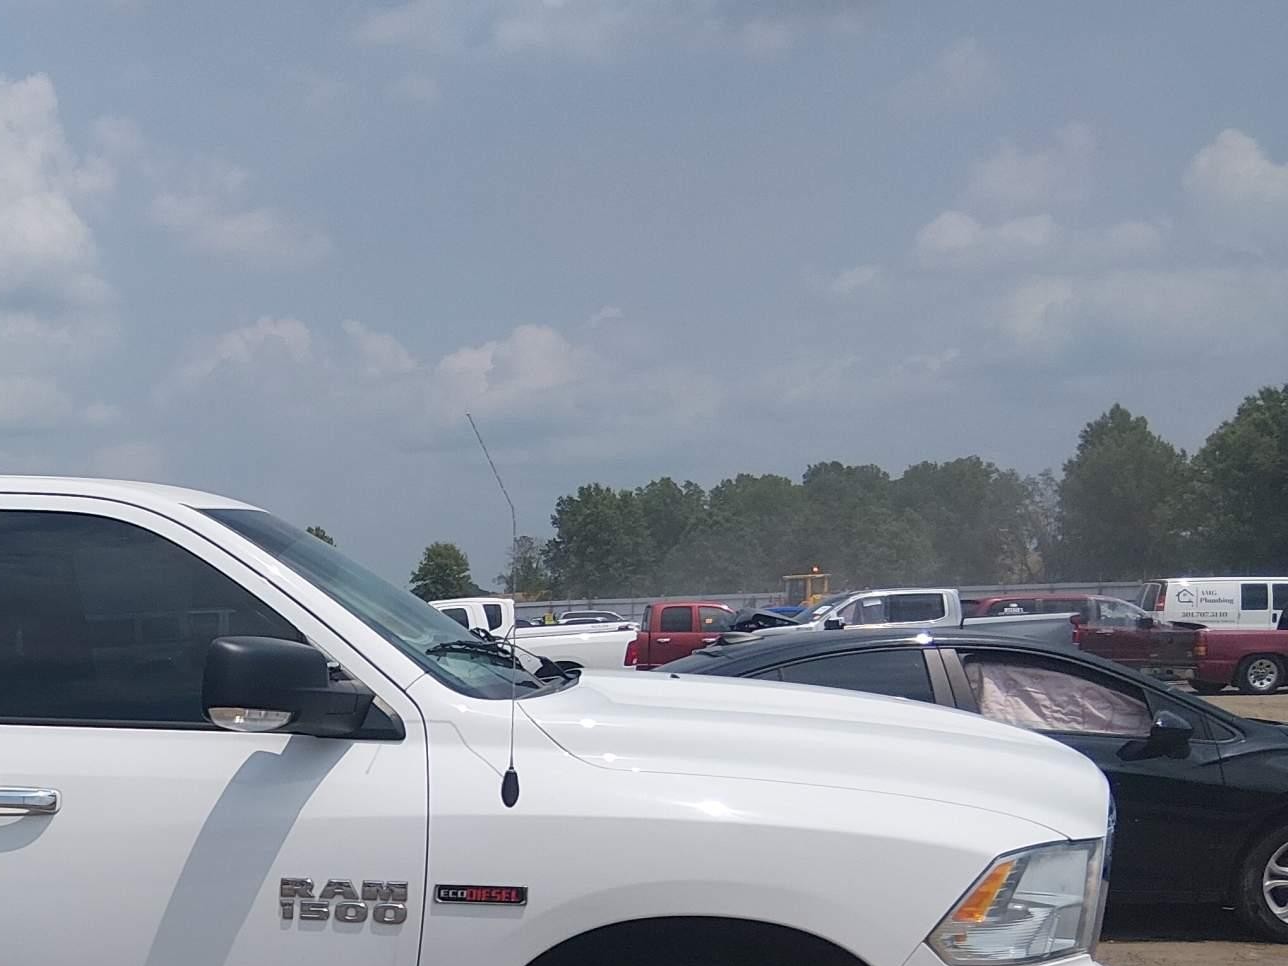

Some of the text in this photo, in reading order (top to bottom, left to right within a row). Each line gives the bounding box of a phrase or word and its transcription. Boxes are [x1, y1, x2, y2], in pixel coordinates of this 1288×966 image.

[280, 877, 408, 901] RAM
[439, 888, 519, 902] ECODIESEL
[279, 900, 407, 924] 1500
